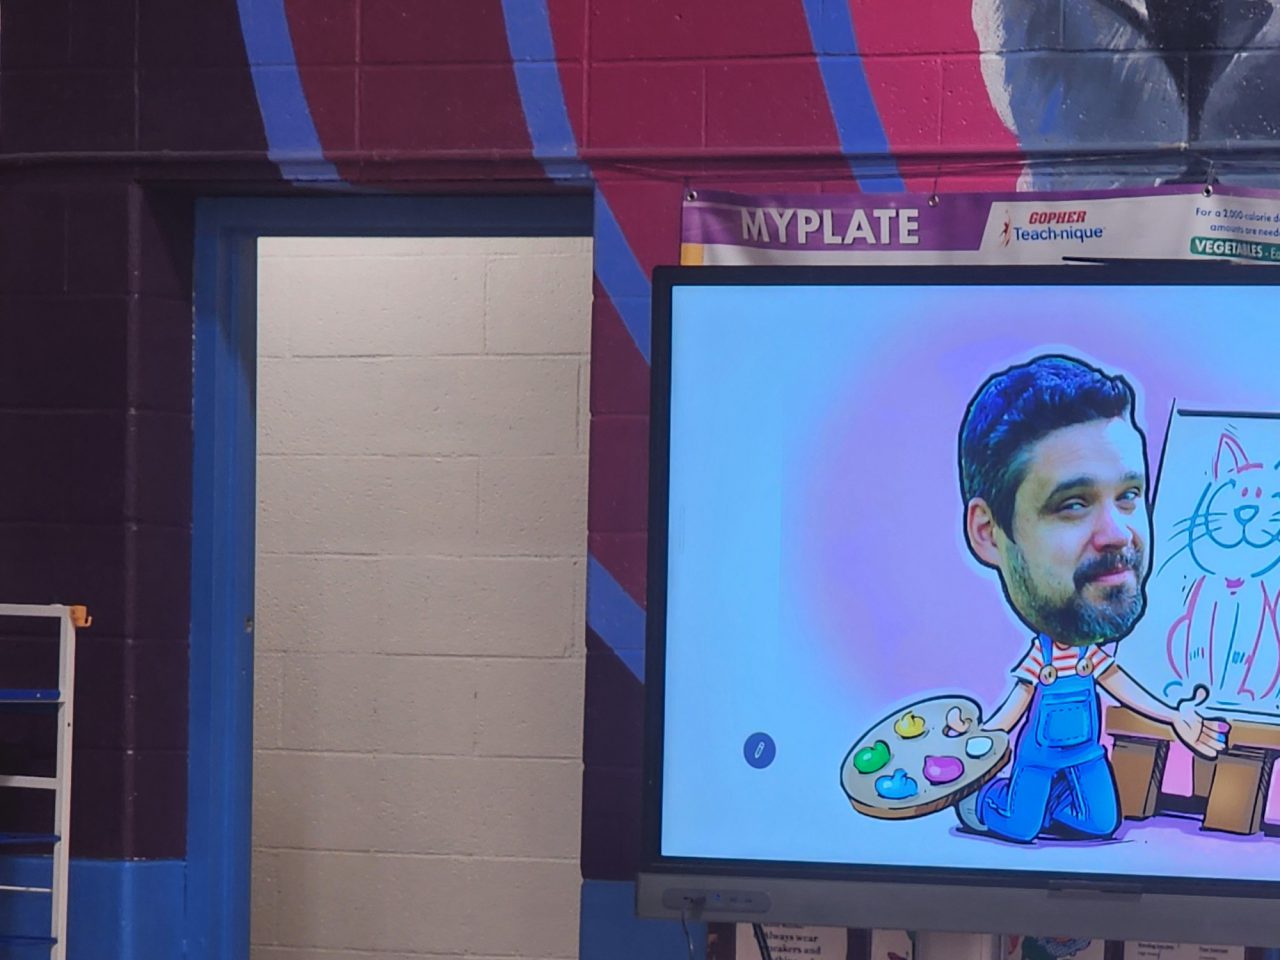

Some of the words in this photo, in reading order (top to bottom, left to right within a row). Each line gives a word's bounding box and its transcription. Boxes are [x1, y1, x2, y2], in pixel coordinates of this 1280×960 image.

[1029, 211, 1087, 225] GOPHER
[1195, 207, 1212, 217] For
[1244, 211, 1271, 222] calorie
[740, 207, 919, 244] MYPLATE
[1210, 223, 1244, 234] amounts
[1245, 226, 1257, 235] are
[803, 946, 821, 955] and
